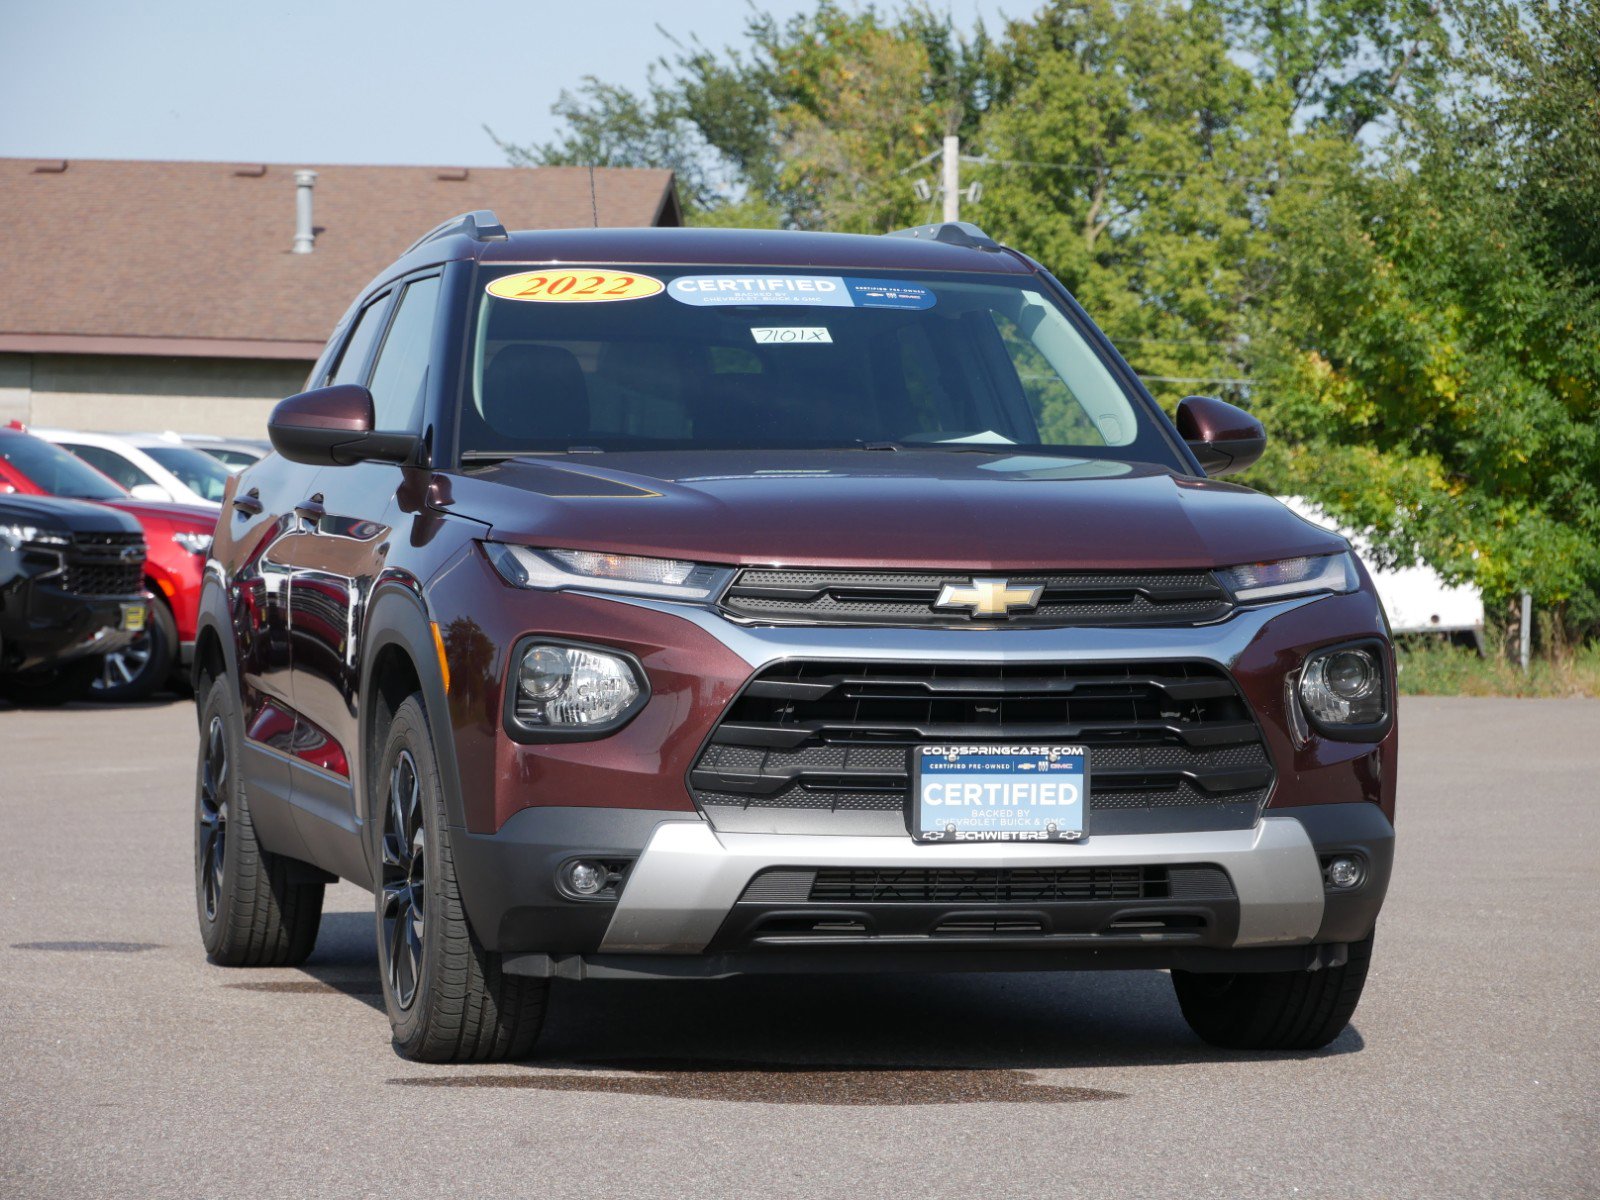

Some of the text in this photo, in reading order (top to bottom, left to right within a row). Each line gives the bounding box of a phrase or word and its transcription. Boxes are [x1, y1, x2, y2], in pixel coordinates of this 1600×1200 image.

[516, 276, 634, 296] 2022
[676, 279, 837, 293] CERTIFIED
[756, 329, 825, 342] 7101X
[922, 746, 1084, 755] COLDSPRINGCARS.COM
[923, 783, 1078, 806] CERTIFIED
[971, 809, 1030, 817] BACKED BY
[935, 818, 1066, 826] CHEVROLET BUICK & GMC
[955, 831, 1049, 840] SCHWIETERS
